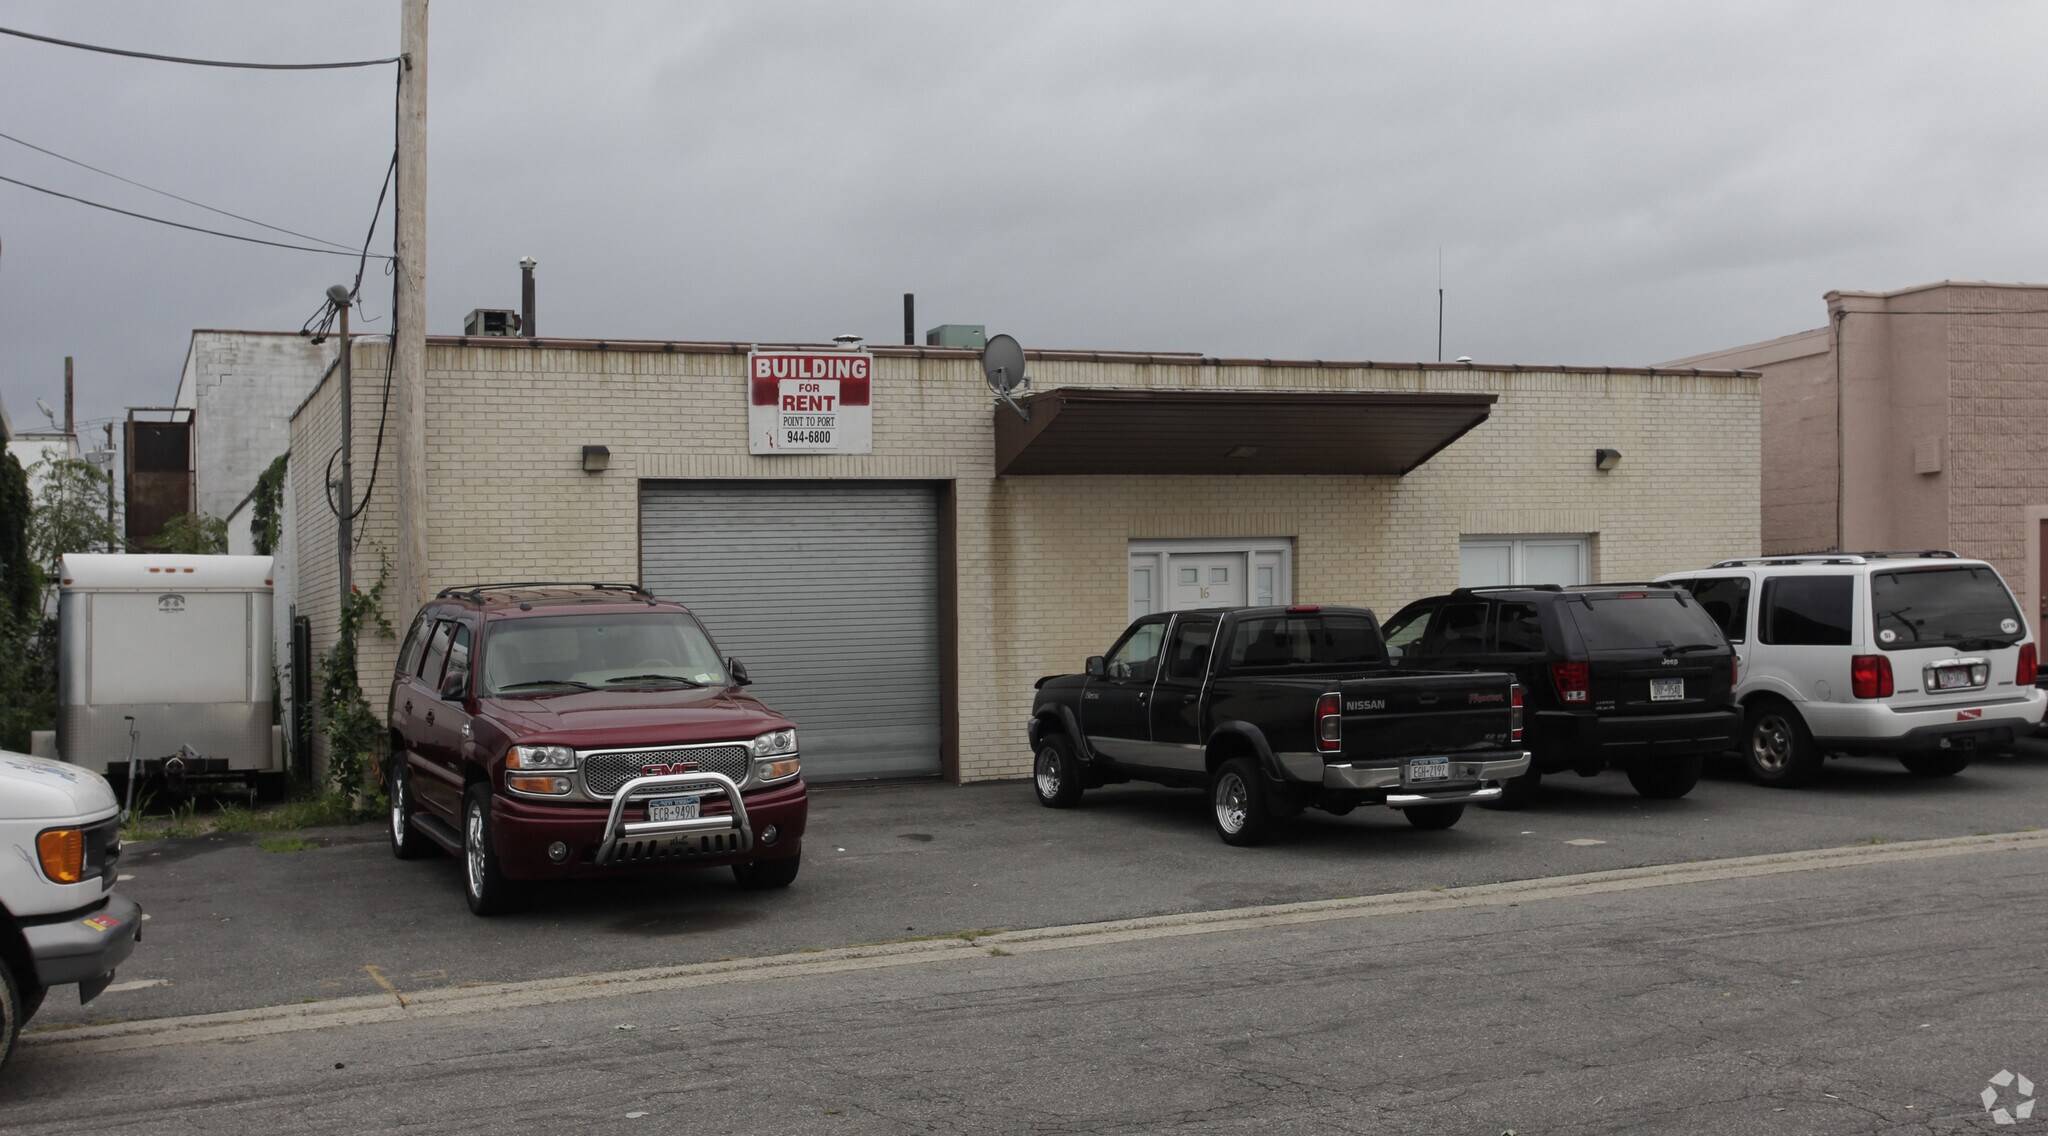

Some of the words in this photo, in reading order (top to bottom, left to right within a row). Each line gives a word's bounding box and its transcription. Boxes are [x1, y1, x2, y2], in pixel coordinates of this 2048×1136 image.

[756, 359, 866, 378] BUILDING
[798, 383, 820, 393] FOR
[782, 395, 836, 412] RENT
[783, 416, 804, 427] POINT
[806, 416, 816, 427] TO
[817, 416, 835, 427] PORT
[787, 430, 831, 443] 944-6800
[1199, 587, 1210, 599] 16
[1661, 657, 1679, 666] Jeep
[1346, 699, 1385, 711] NISSAN
[641, 761, 699, 777] GMC
